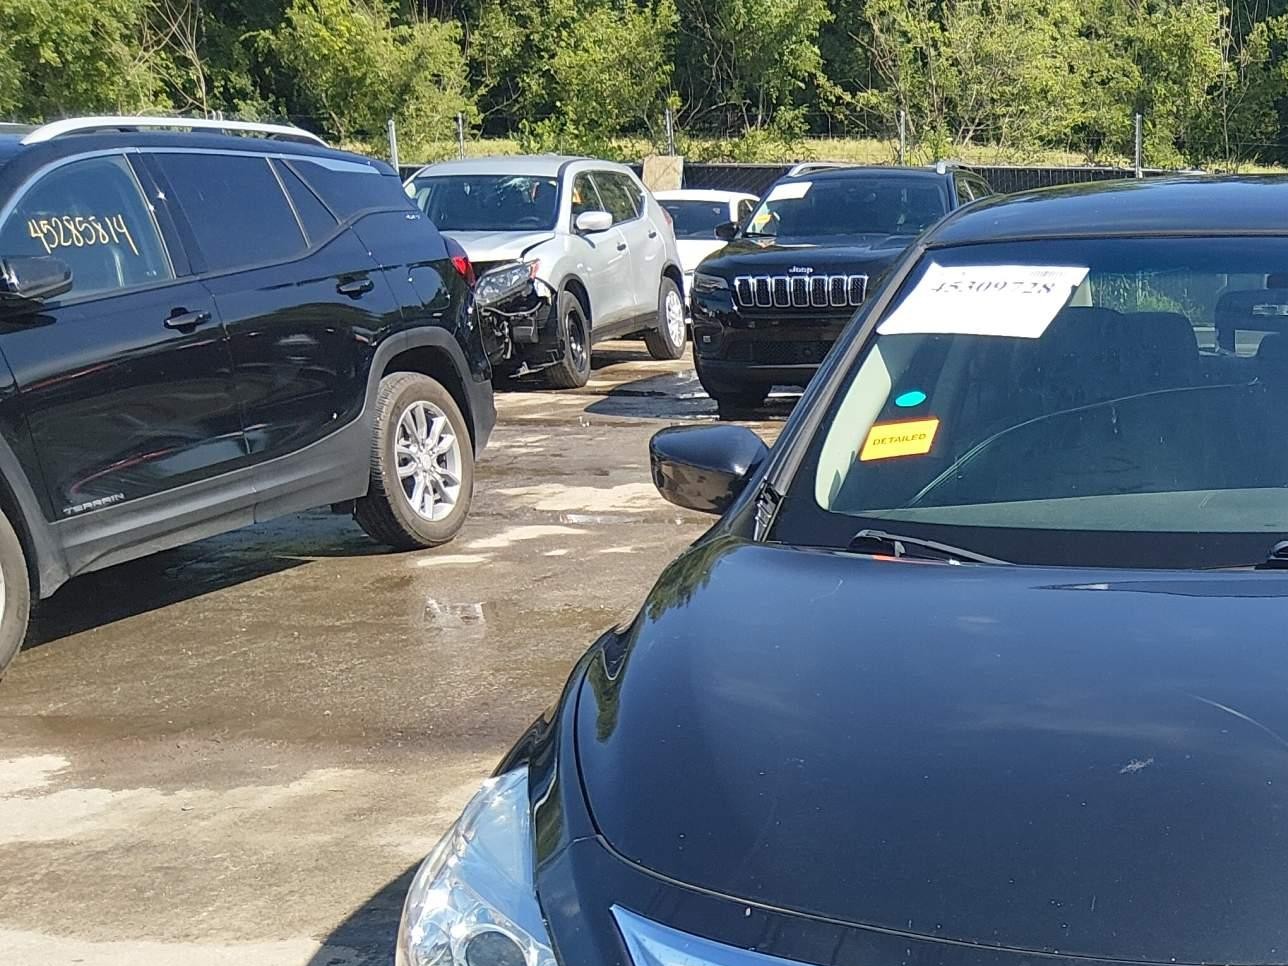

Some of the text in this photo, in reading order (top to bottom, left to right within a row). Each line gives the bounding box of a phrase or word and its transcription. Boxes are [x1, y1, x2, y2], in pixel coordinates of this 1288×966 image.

[28, 214, 139, 255] 45285814
[789, 265, 813, 274] Jeep
[872, 433, 927, 446] DETAILED
[63, 492, 125, 515] TERRAIN
